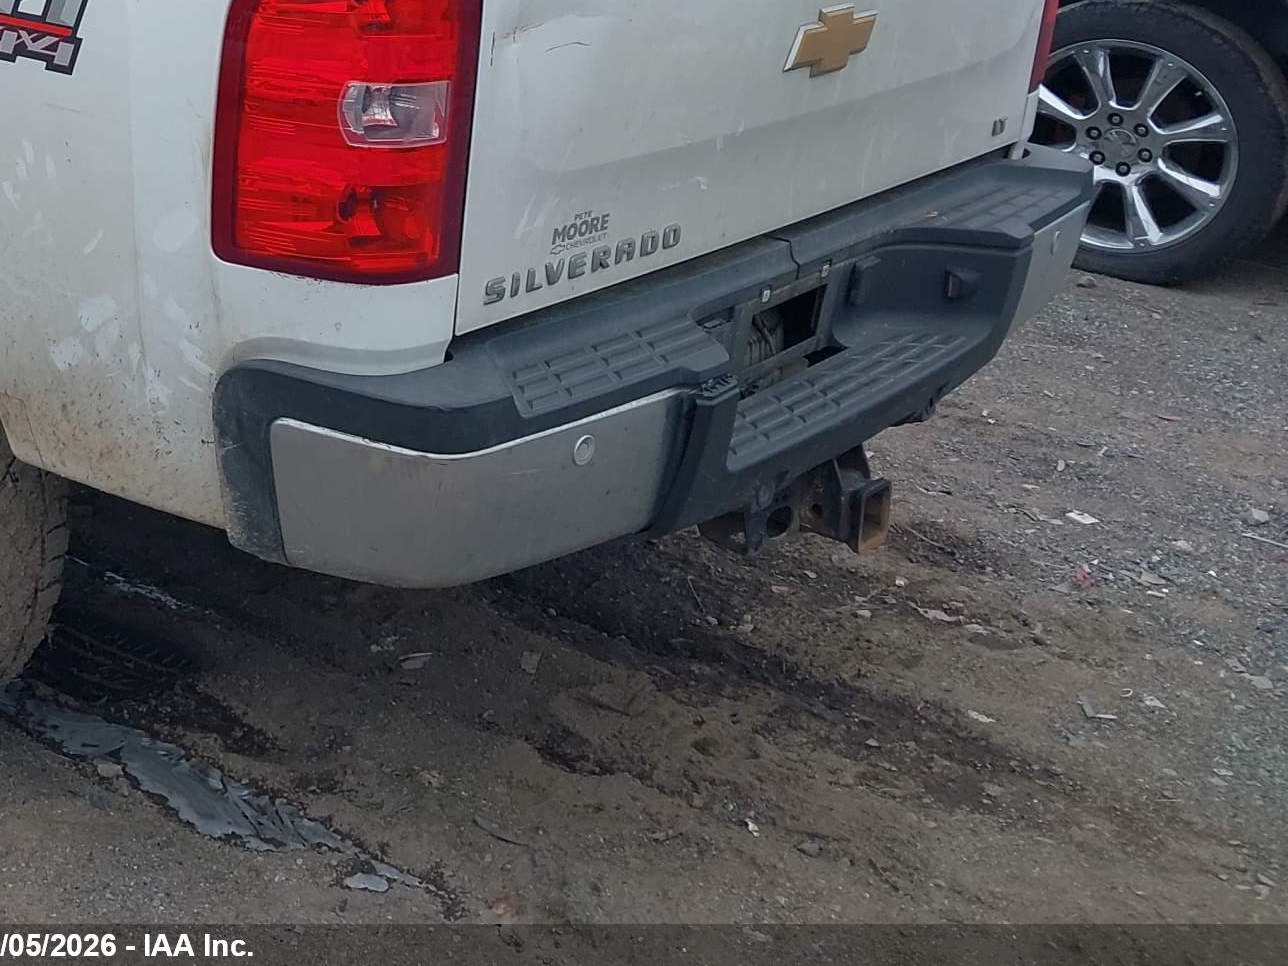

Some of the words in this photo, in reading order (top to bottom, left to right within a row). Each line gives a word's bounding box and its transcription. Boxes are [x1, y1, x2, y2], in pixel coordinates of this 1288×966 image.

[574, 210, 593, 222] PETE
[551, 213, 611, 246] MOORE
[565, 232, 608, 251] CHEVROLET
[483, 223, 682, 306] SILVERADO
